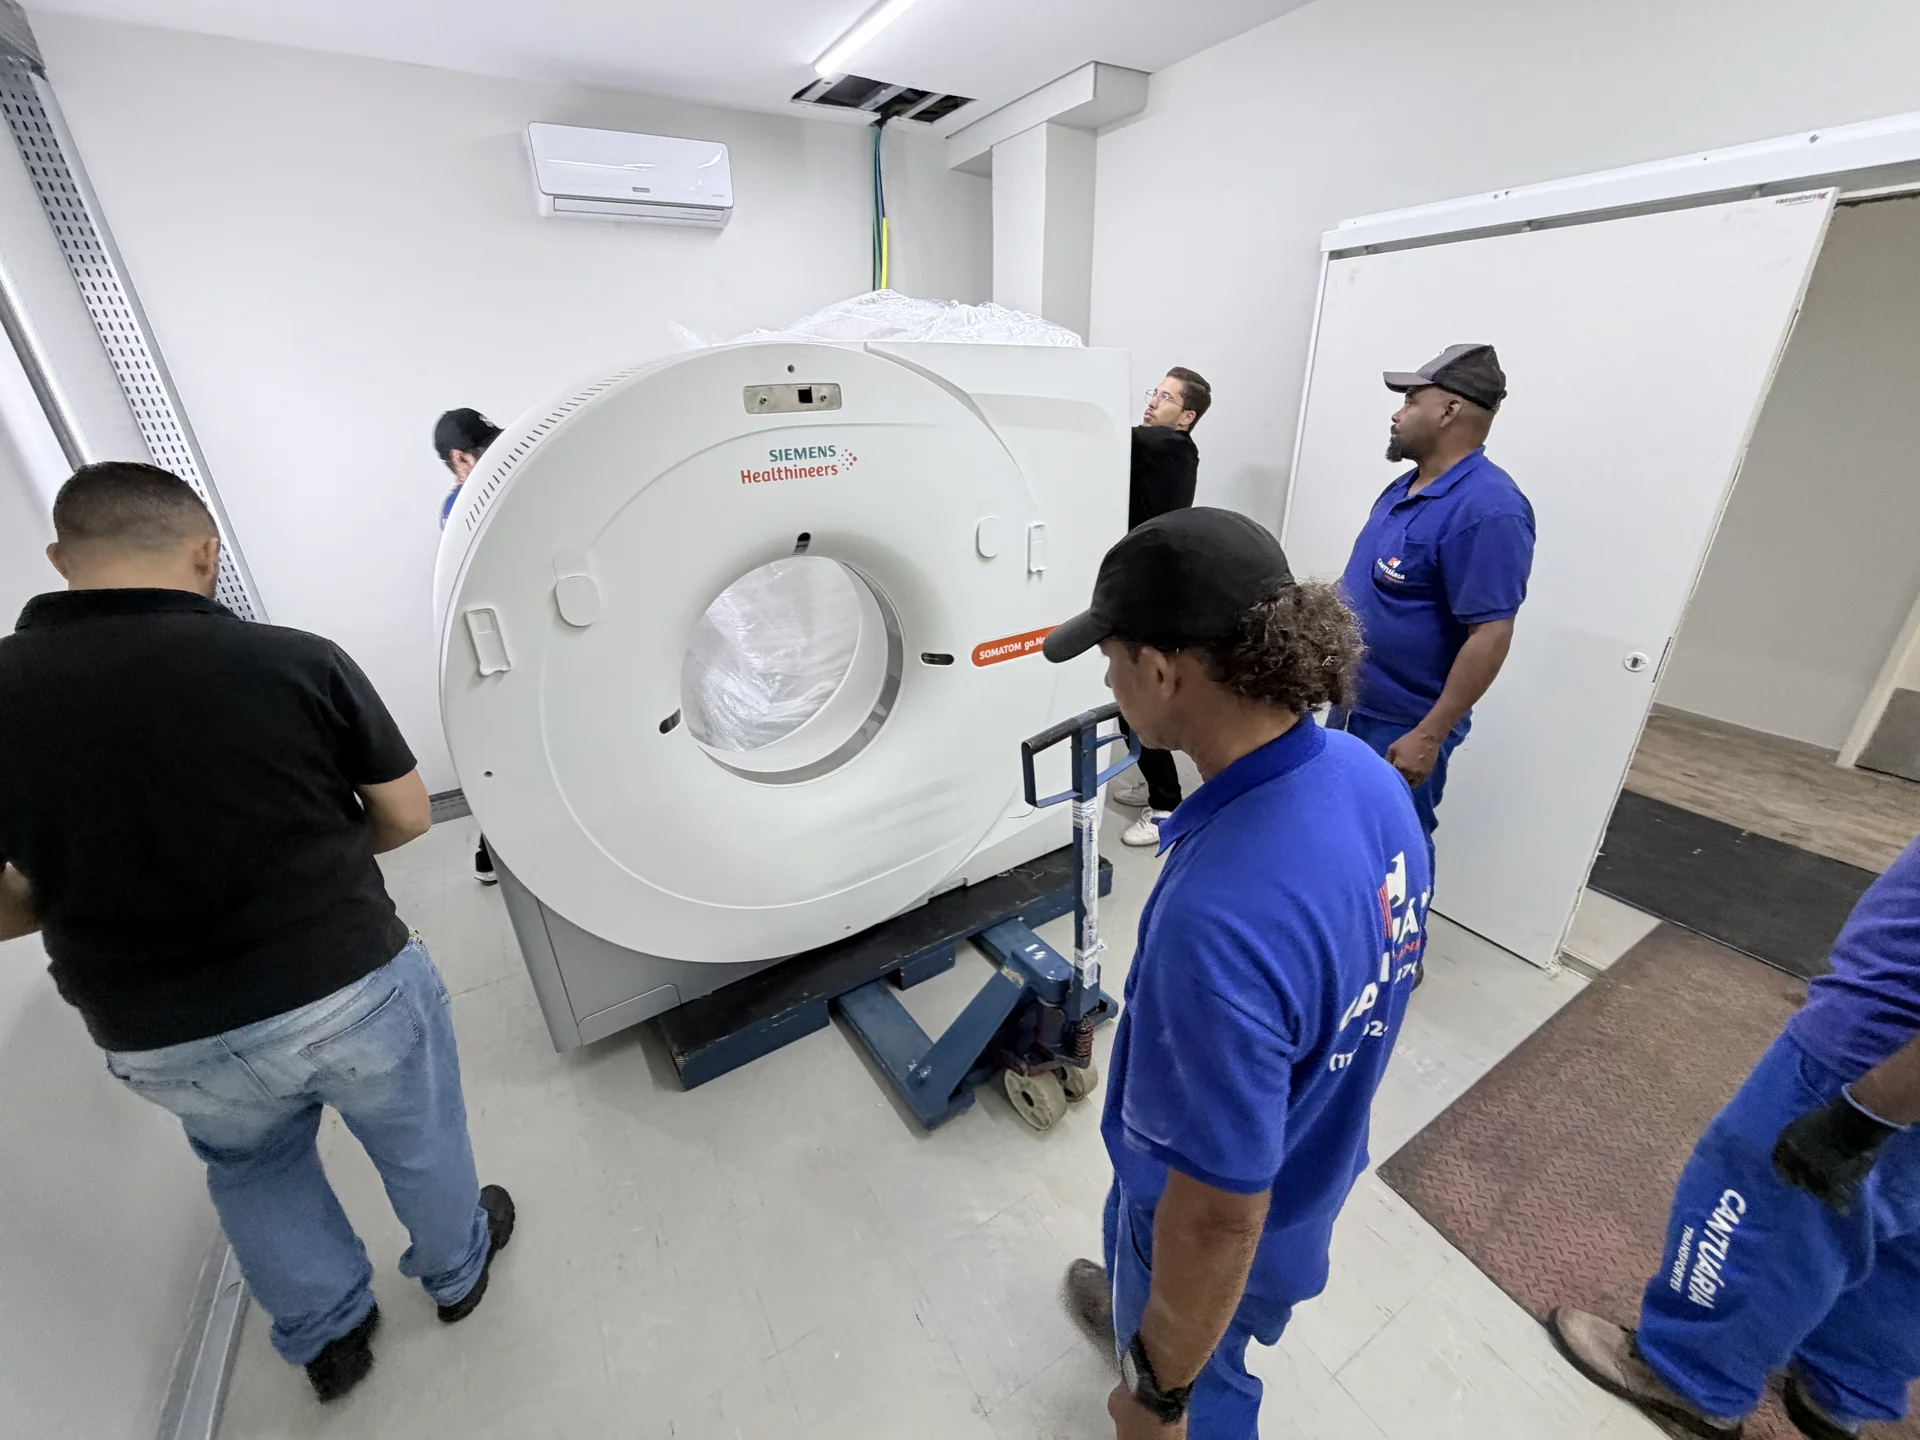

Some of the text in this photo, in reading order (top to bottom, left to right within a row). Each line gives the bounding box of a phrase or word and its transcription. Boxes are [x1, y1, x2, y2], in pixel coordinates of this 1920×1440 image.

[769, 445, 837, 462] SIEMENS
[740, 464, 839, 484] Healthineers
[979, 642, 1022, 660] SOMATOM
[1670, 1224, 1695, 1294] TRANSPORTES
[1687, 1189, 1747, 1309] CANTUÁRIA
